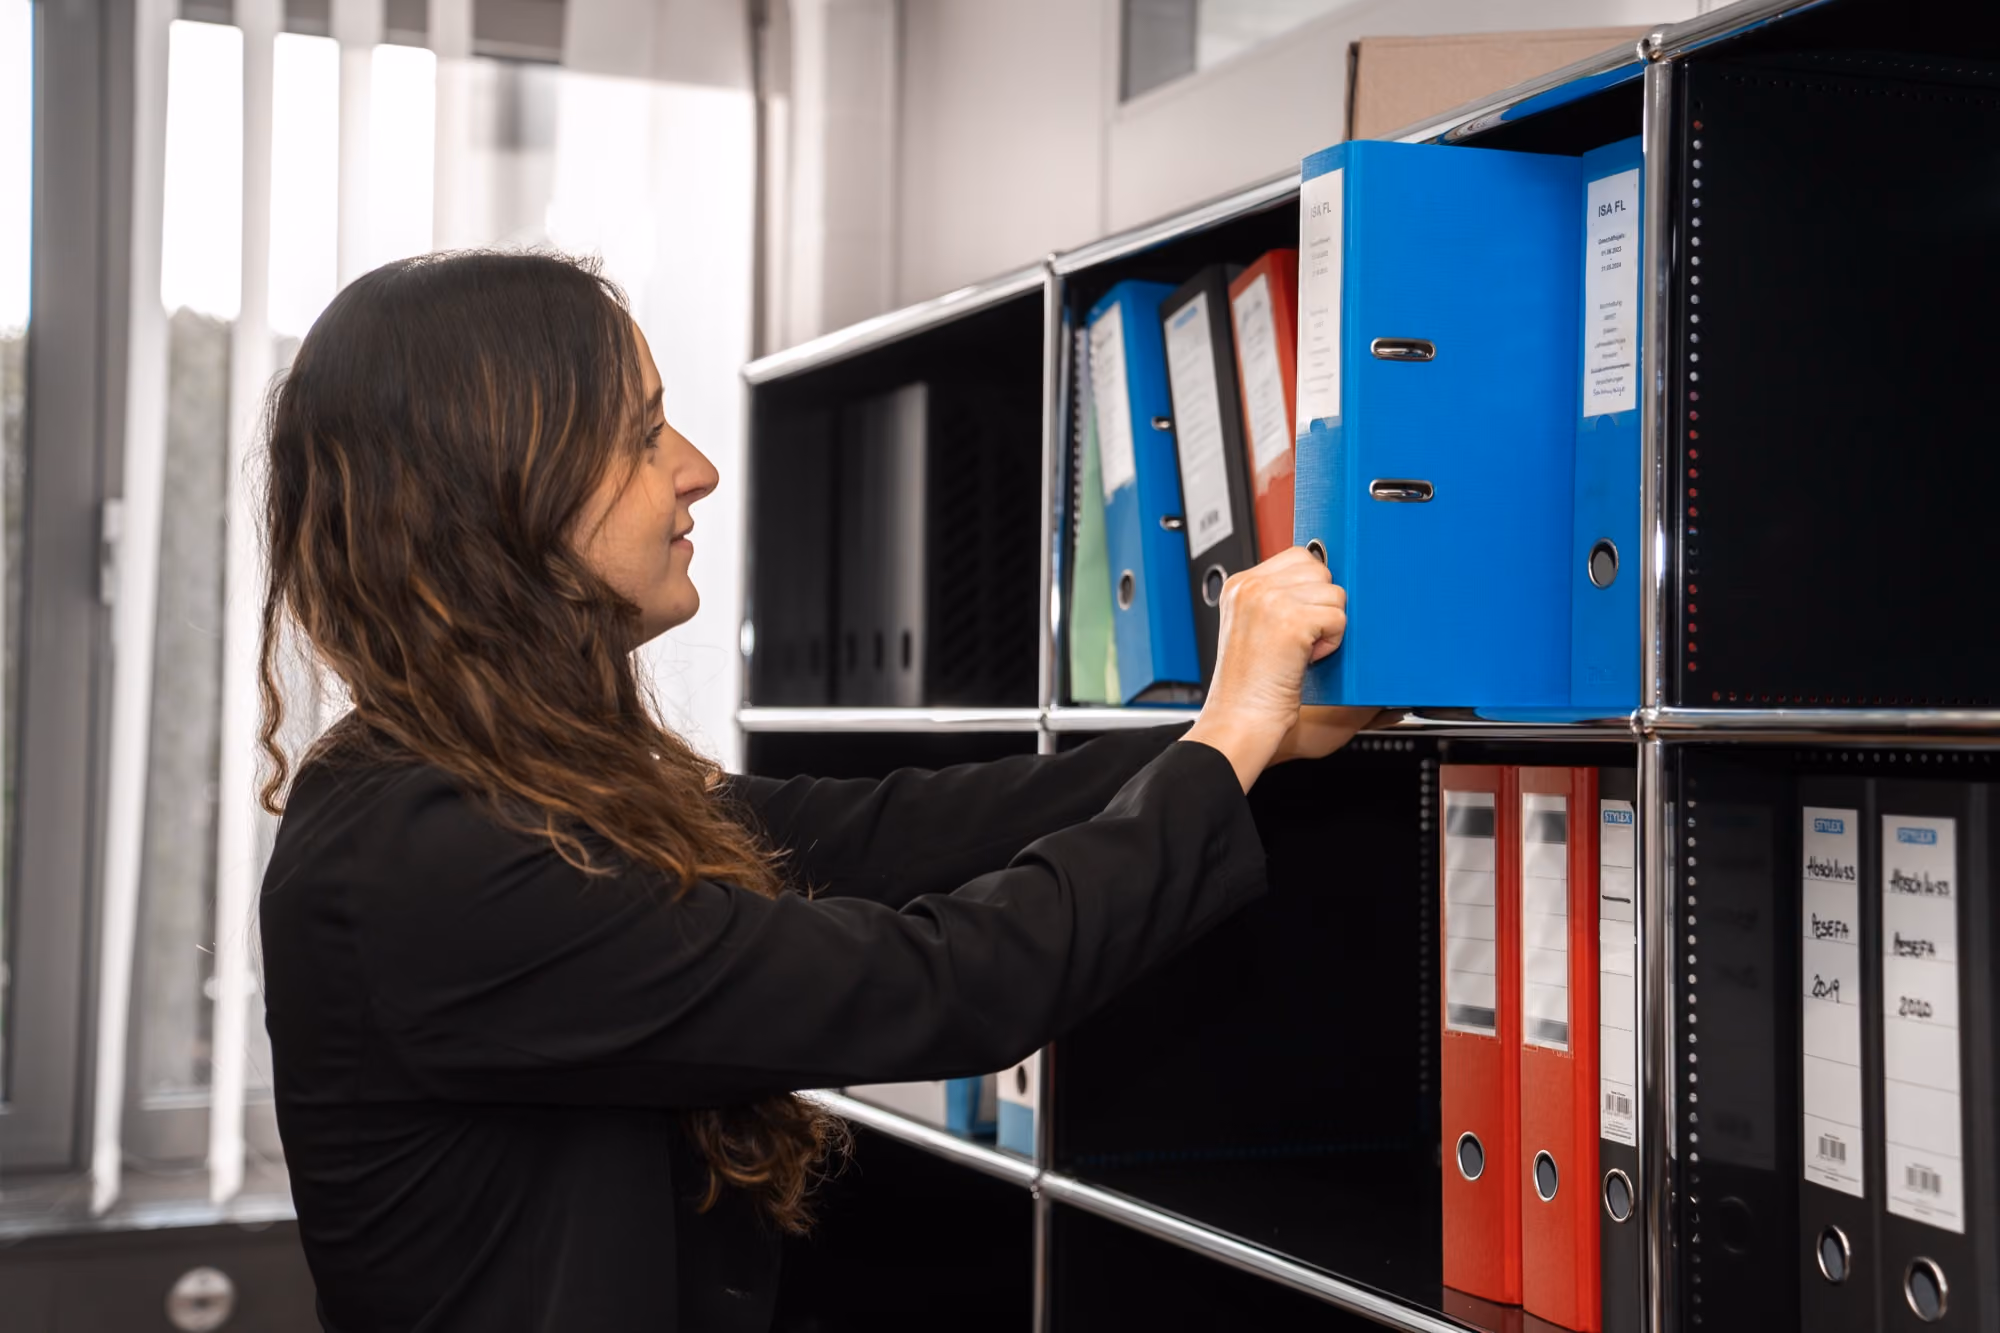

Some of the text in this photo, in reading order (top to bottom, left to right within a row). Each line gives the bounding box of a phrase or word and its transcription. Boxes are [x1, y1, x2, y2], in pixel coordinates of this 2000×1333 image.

[1598, 200, 1626, 217] ISA FL
[1605, 812, 1630, 823] STYLEX
[1814, 819, 1842, 832] STYLEX
[1812, 974, 1840, 1004] 2019
